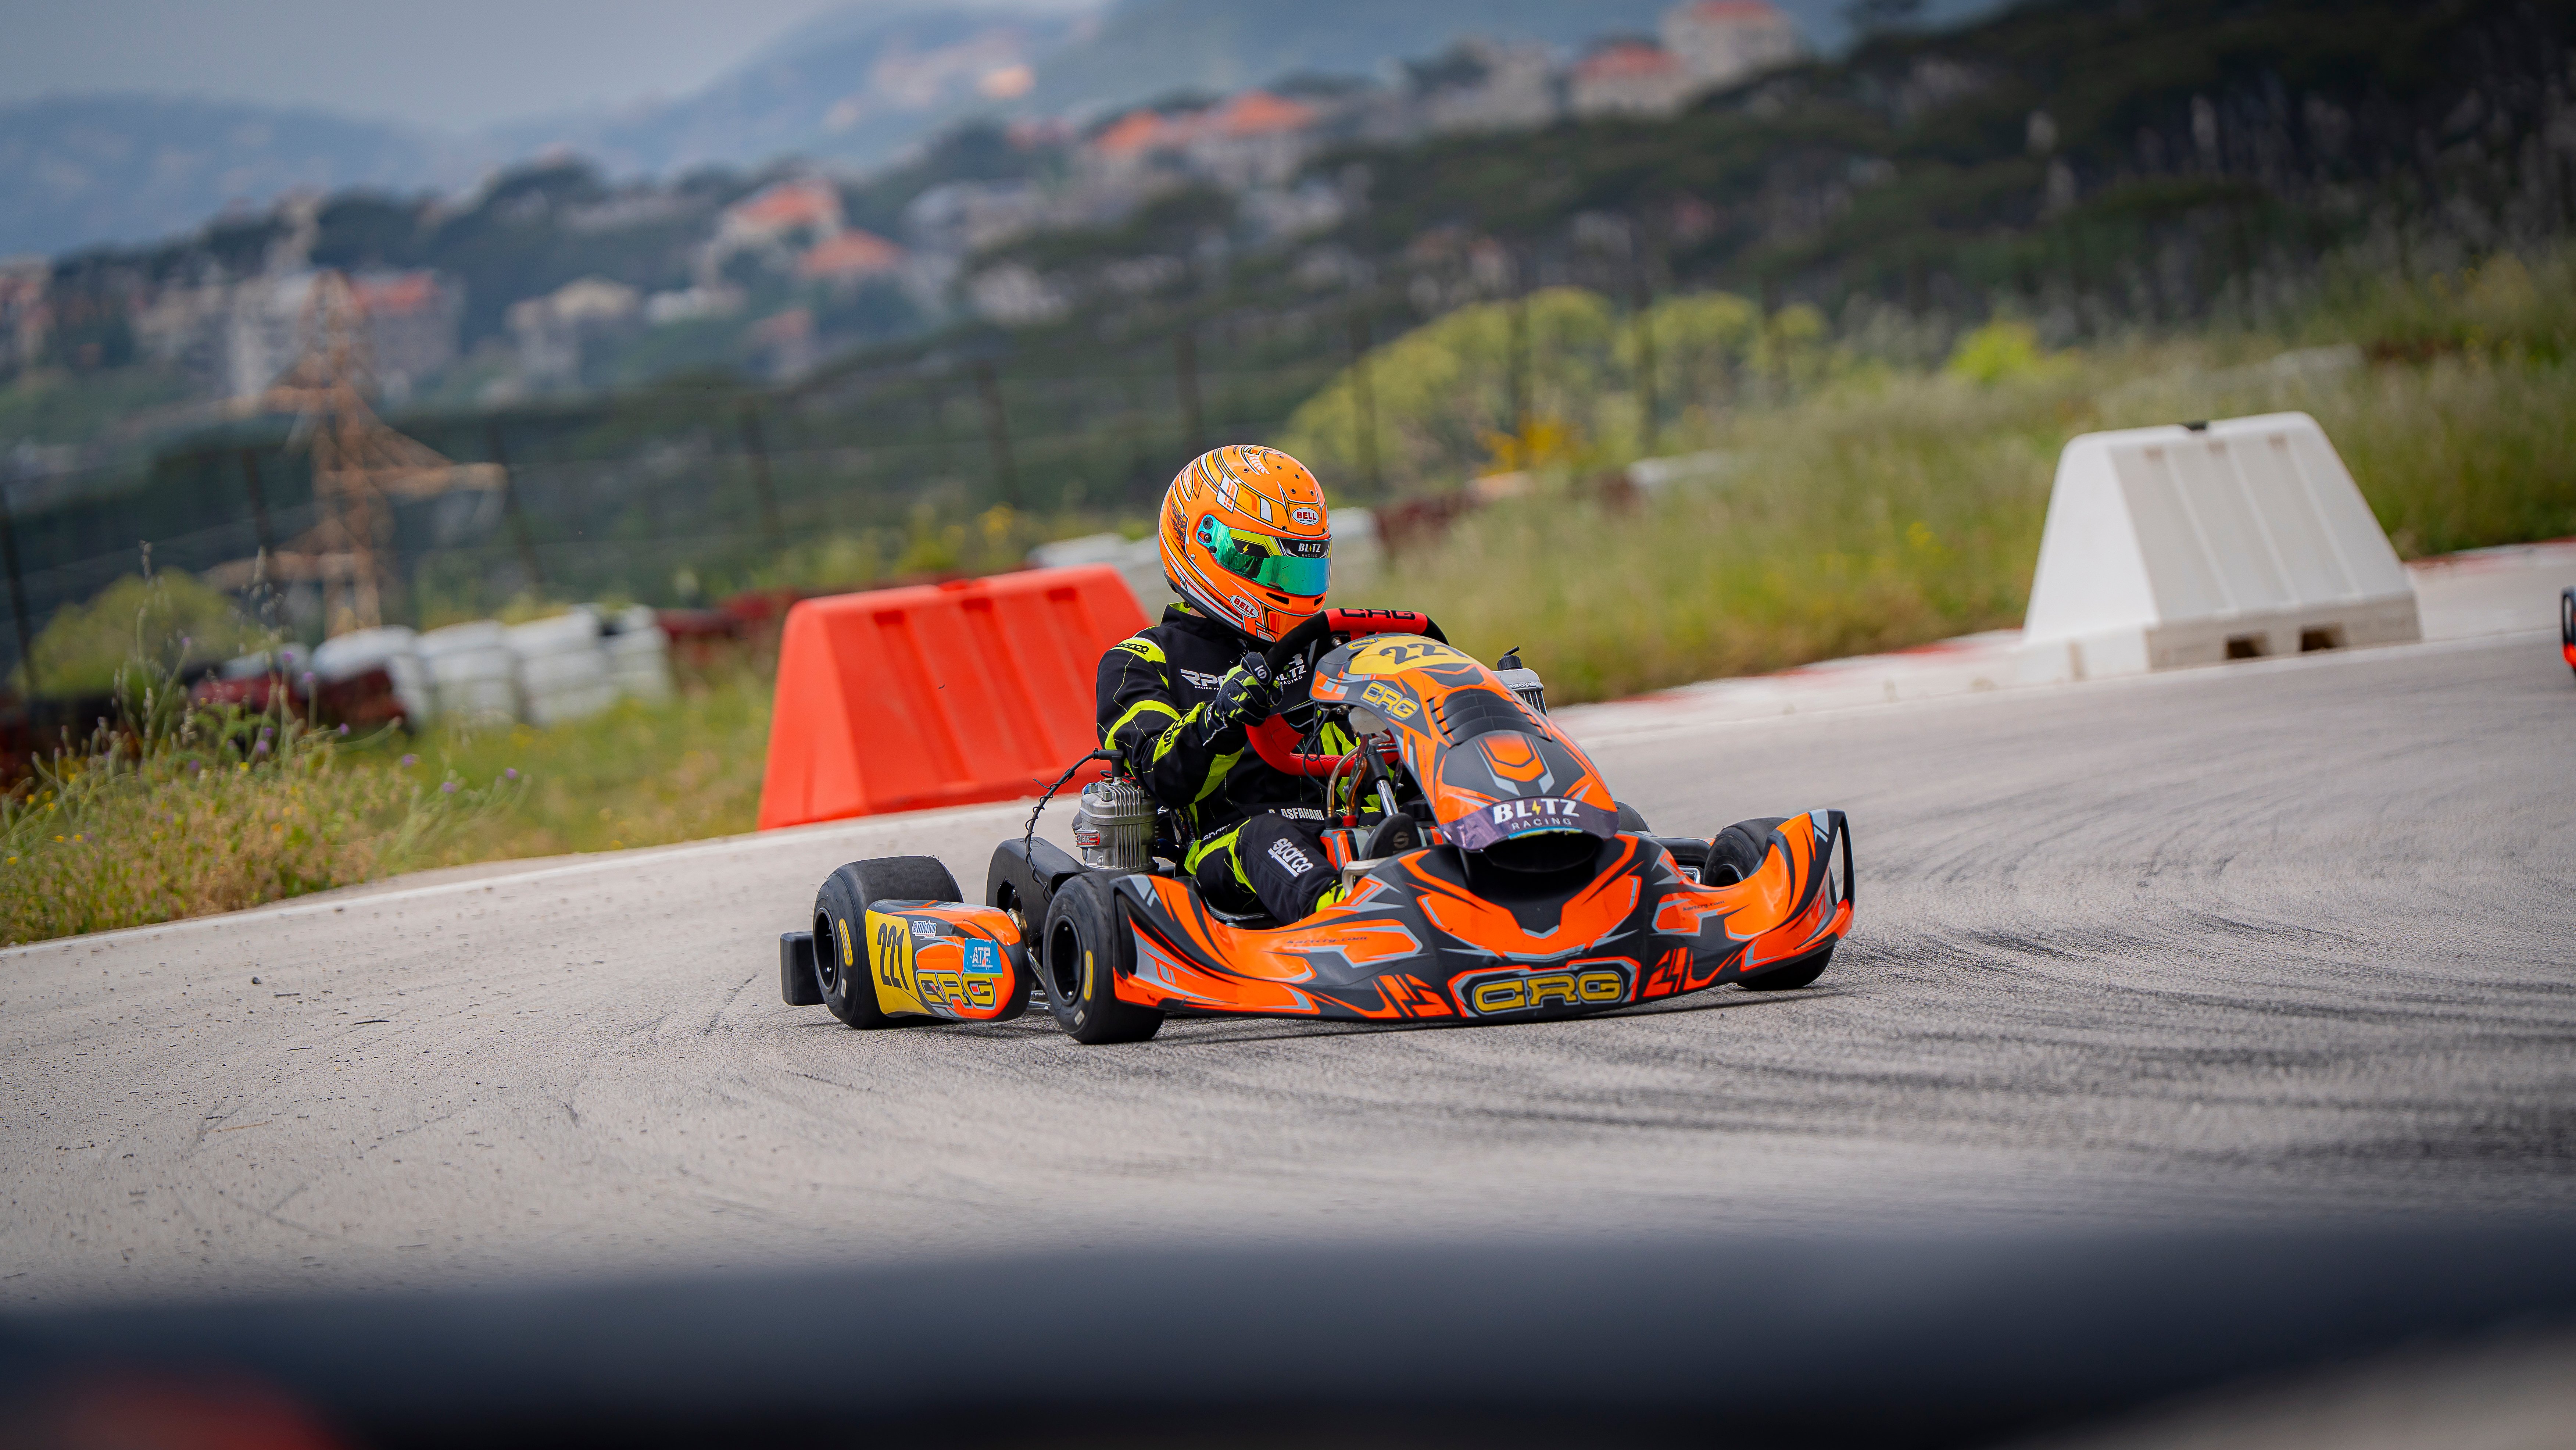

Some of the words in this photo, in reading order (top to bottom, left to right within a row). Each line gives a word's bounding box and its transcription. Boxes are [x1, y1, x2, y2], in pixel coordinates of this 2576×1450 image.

[1297, 511, 1317, 520] BELL
[1234, 597, 1254, 616] BELL
[1339, 608, 1416, 620] CRG
[1361, 682, 1419, 719] CRG
[1511, 817, 1572, 831] RACING
[1270, 838, 1314, 875] sparco
[916, 921, 936, 933] Tillotson
[877, 923, 910, 991] 221
[916, 972, 995, 1008] CRG
[1474, 972, 1622, 1013] CRG
